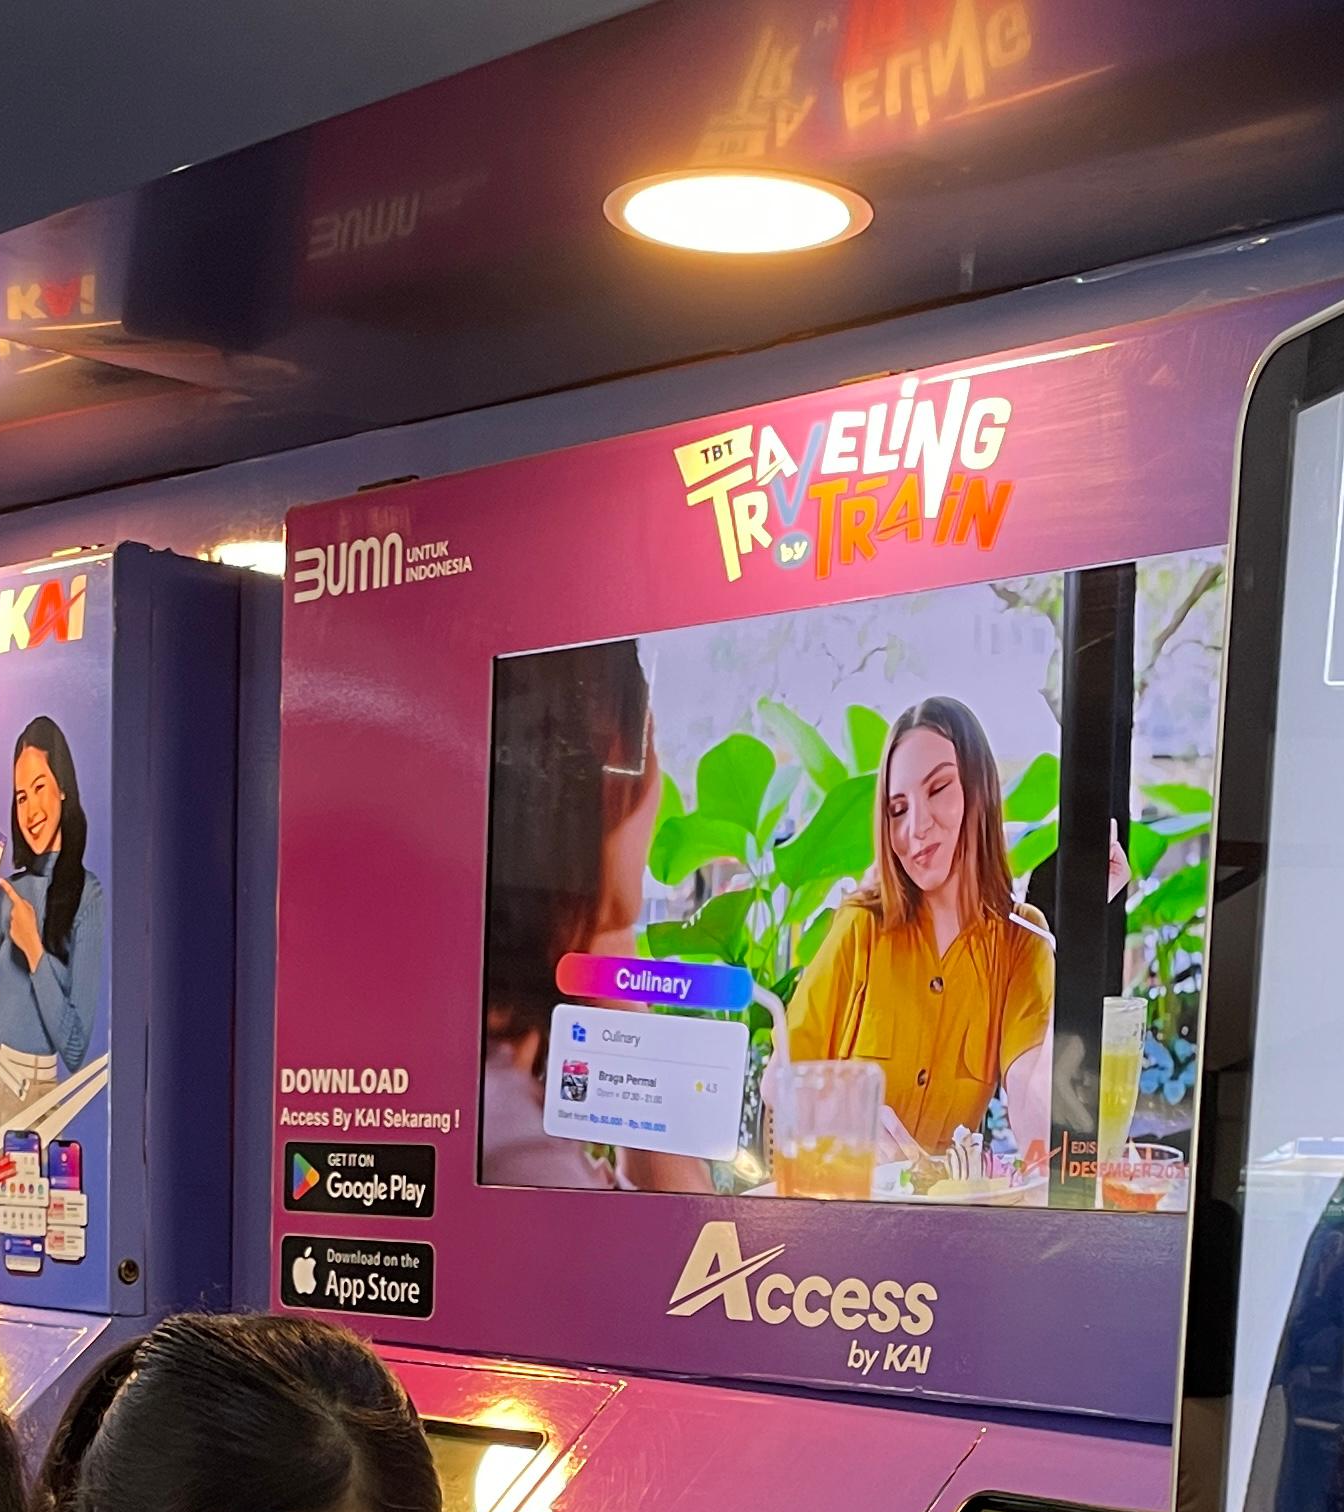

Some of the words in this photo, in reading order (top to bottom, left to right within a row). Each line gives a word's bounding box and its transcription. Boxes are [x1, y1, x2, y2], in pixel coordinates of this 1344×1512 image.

[699, 438, 734, 465] TBT
[779, 540, 809, 563] by
[293, 532, 403, 604] BUMN
[406, 540, 450, 563] UNTUK
[405, 555, 473, 583] INDONESIA
[615, 967, 693, 1000] Culinary
[601, 1028, 641, 1048] Culinary
[280, 1067, 410, 1094] DOWNLOAD
[598, 1070, 624, 1085] Braga
[625, 1073, 657, 1088] Permai
[279, 1107, 330, 1128] Access
[332, 1108, 353, 1131] By
[354, 1109, 381, 1128] KAI
[383, 1109, 451, 1134] Sekarang
[327, 1152, 346, 1168] GET
[358, 1153, 375, 1168] ON
[326, 1171, 388, 1207] Google
[390, 1174, 426, 1209] Play
[326, 1248, 381, 1267] Download
[383, 1253, 398, 1267] on
[400, 1252, 420, 1269] the
[324, 1269, 365, 1306] App
[367, 1272, 420, 1304] Store
[665, 1221, 938, 1336] Access
[847, 1340, 879, 1375] by
[883, 1343, 932, 1374] KAI
